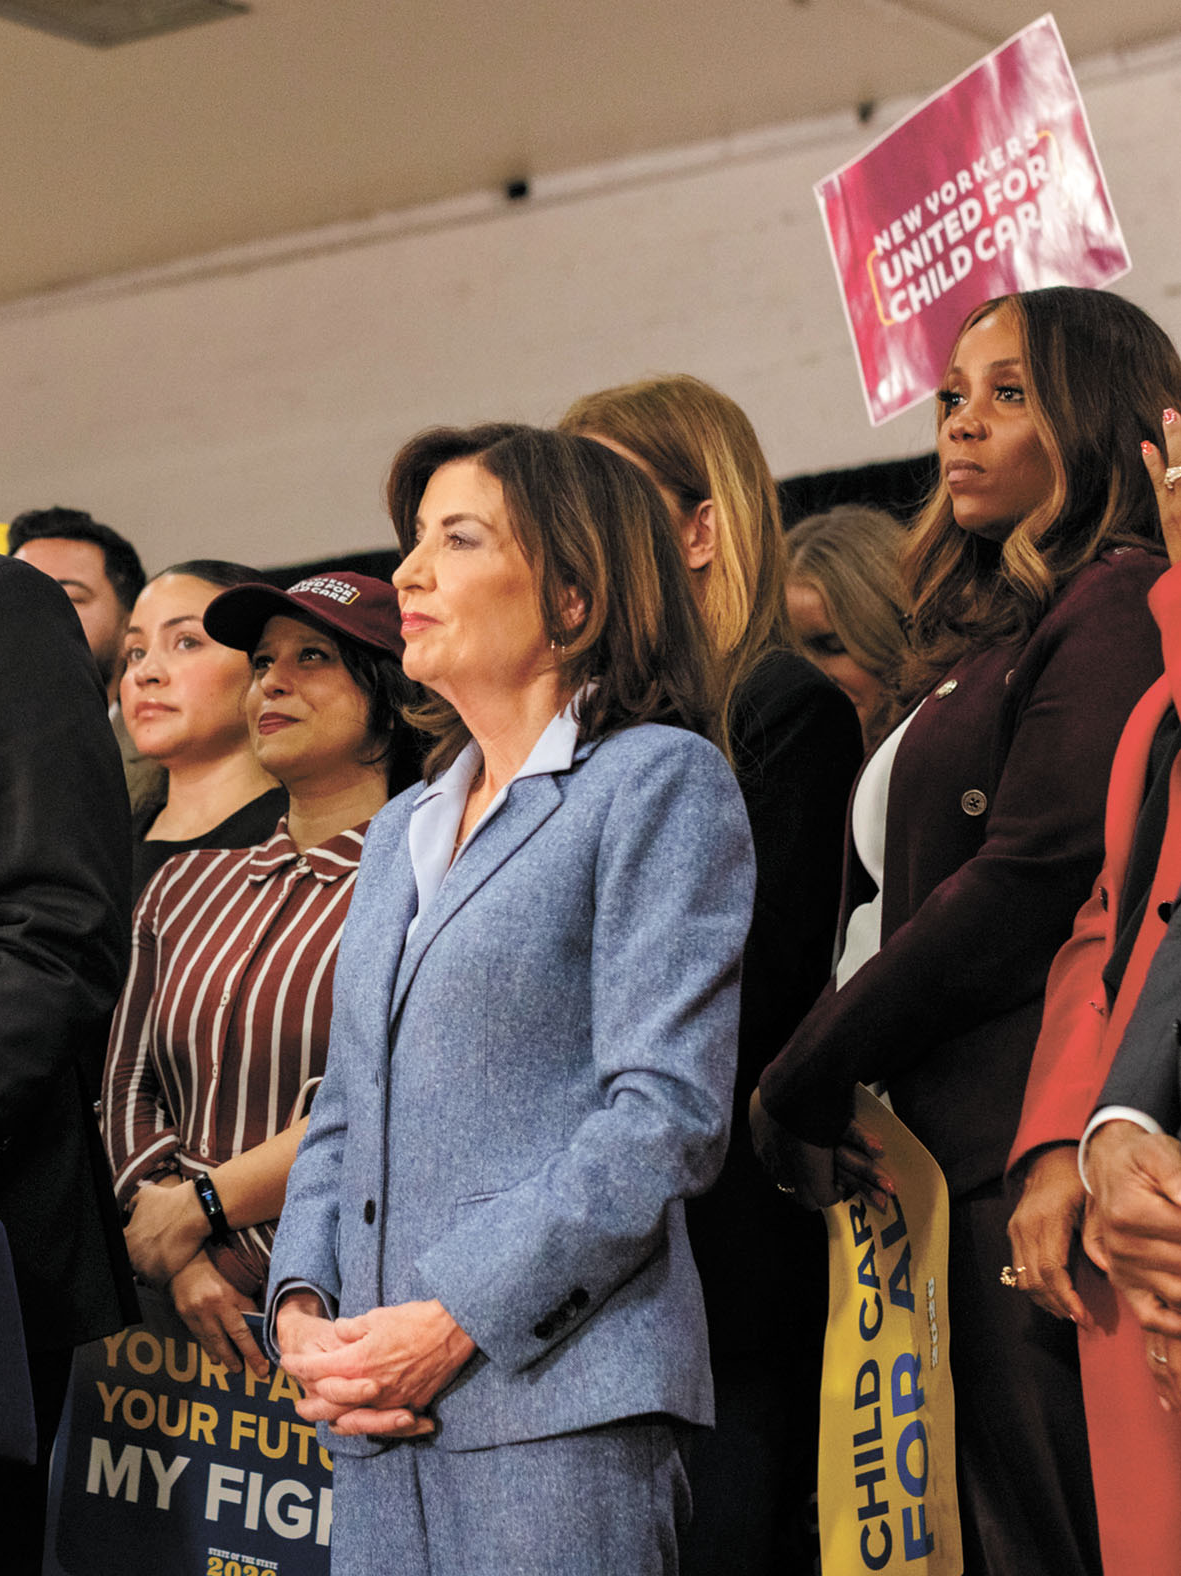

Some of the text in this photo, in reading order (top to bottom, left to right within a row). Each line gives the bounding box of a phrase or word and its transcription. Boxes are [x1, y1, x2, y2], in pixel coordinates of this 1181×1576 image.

[873, 126, 1039, 256] NEW YORKERS
[879, 155, 1051, 288] UNITED FOR
[889, 202, 1044, 323] CHILD CAR
[311, 587, 348, 603] CARE
[325, 583, 353, 597] FOR
[103, 1329, 306, 1404] YOUR FA
[849, 1198, 893, 1571] CHILD CAR
[880, 1194, 935, 1562] FOR AL
[95, 1381, 219, 1445] YOUR
[86, 1437, 191, 1511] MY
[208, 1547, 230, 1559] STATE
[230, 1552, 241, 1561] OF
[256, 1558, 278, 1570] STATE
